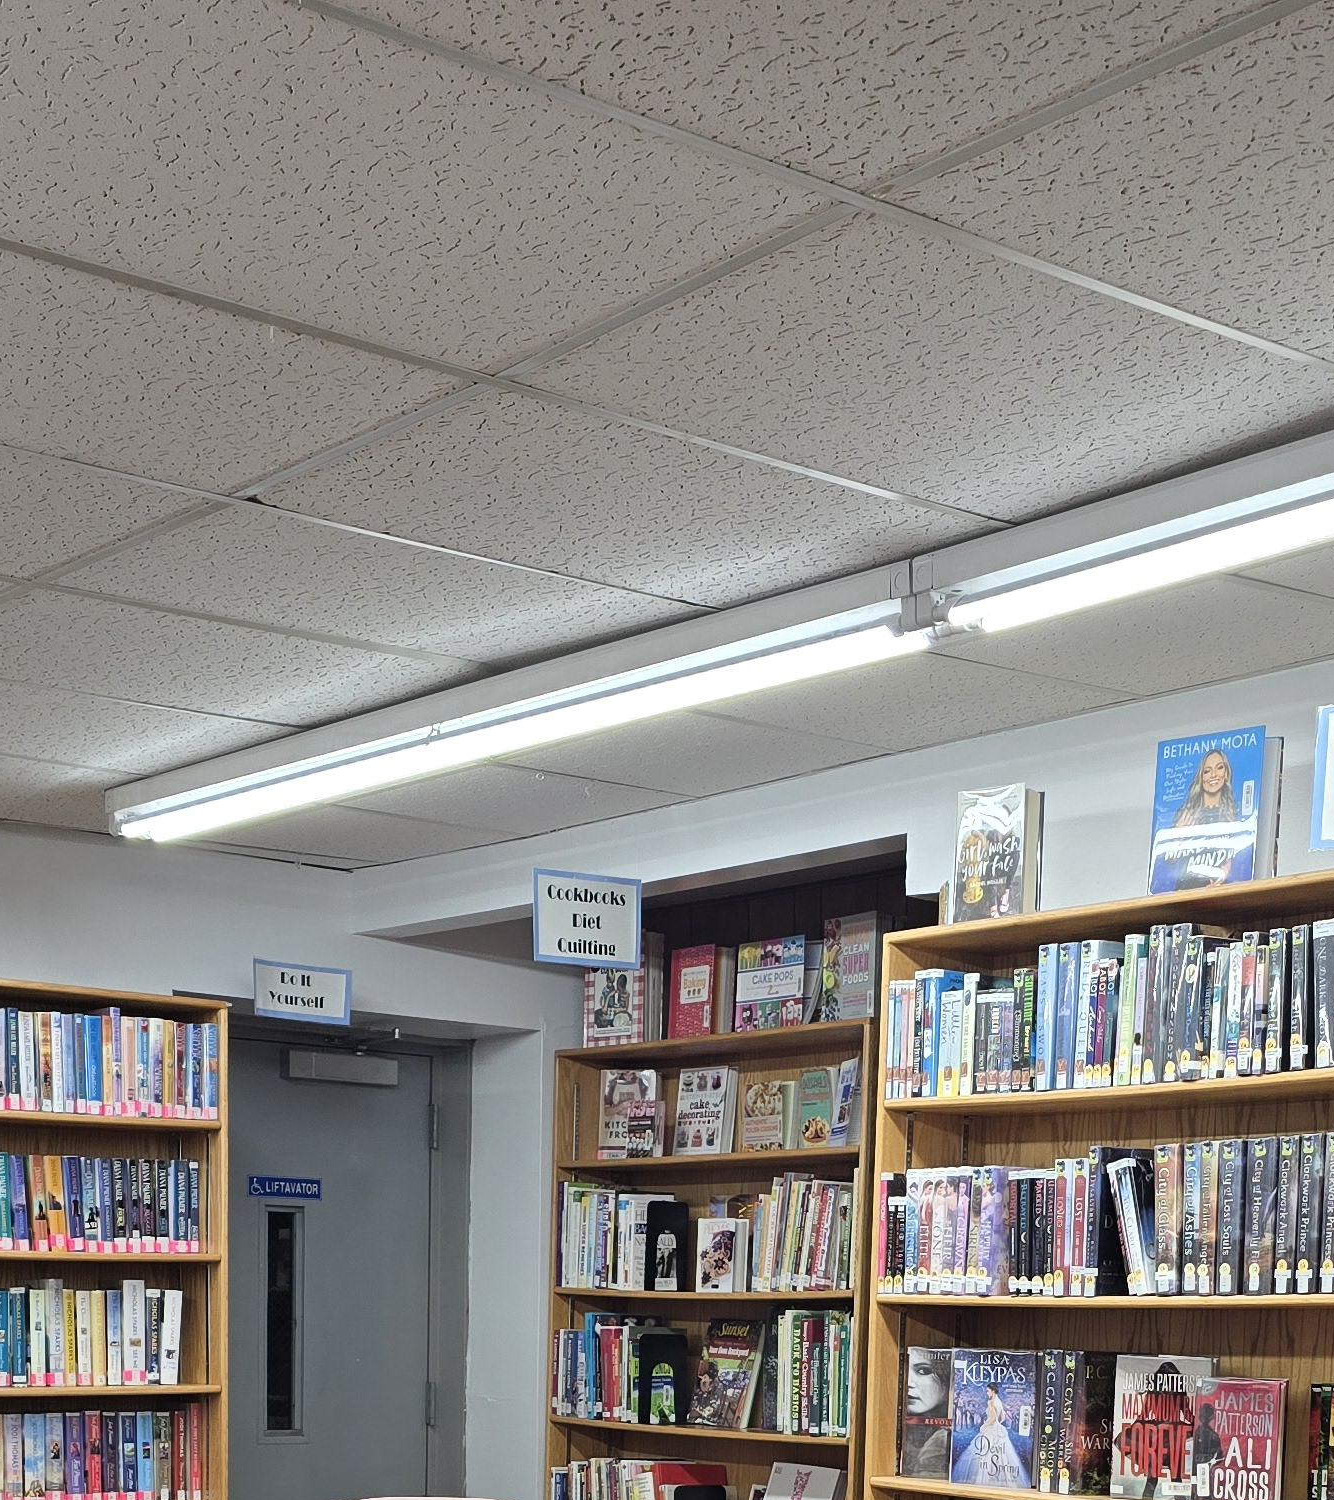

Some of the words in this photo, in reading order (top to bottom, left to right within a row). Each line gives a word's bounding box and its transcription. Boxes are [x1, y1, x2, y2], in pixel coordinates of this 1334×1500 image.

[1163, 739, 1216, 759] BETHANY
[1222, 733, 1257, 750] MOTA
[989, 836, 1018, 857] wash
[961, 860, 989, 882] your
[992, 855, 1014, 876] face
[547, 884, 626, 906] Cookbooks
[572, 913, 602, 929] Diet
[557, 937, 616, 956] Quilting
[843, 943, 869, 956] CLEAN
[842, 953, 869, 974] SUPER
[280, 972, 298, 985] Do
[300, 975, 312, 987] It
[683, 976, 707, 989] Baking
[752, 972, 772, 984] CAKE
[774, 970, 794, 982] POPS
[842, 972, 869, 985] FOODS
[269, 991, 325, 1008] Yourself
[940, 1000, 950, 1046] Women
[678, 1108, 720, 1120] decorating
[689, 1099, 710, 1110] cake
[265, 1181, 319, 1195] LIFTAVATOR
[1279, 1160, 1290, 1216] Clockwork
[1302, 1155, 1313, 1214] Clockwork
[1184, 1215, 1194, 1256] Ashes
[1276, 1219, 1287, 1253] Angel
[1299, 1216, 1309, 1252] Prince
[717, 1322, 749, 1338] Sunset
[980, 1354, 1010, 1366] LISA
[962, 1362, 1026, 1385] KLEYPAS
[1122, 1372, 1154, 1393] JAMES
[1046, 1387, 1055, 1423] CAST
[1216, 1392, 1274, 1412] JAMES
[1214, 1411, 1274, 1438] PATTERSON
[975, 1435, 1006, 1457] Devil
[1224, 1437, 1272, 1470] ALI
[980, 1459, 988, 1470] in
[987, 1456, 1020, 1480] Spring
